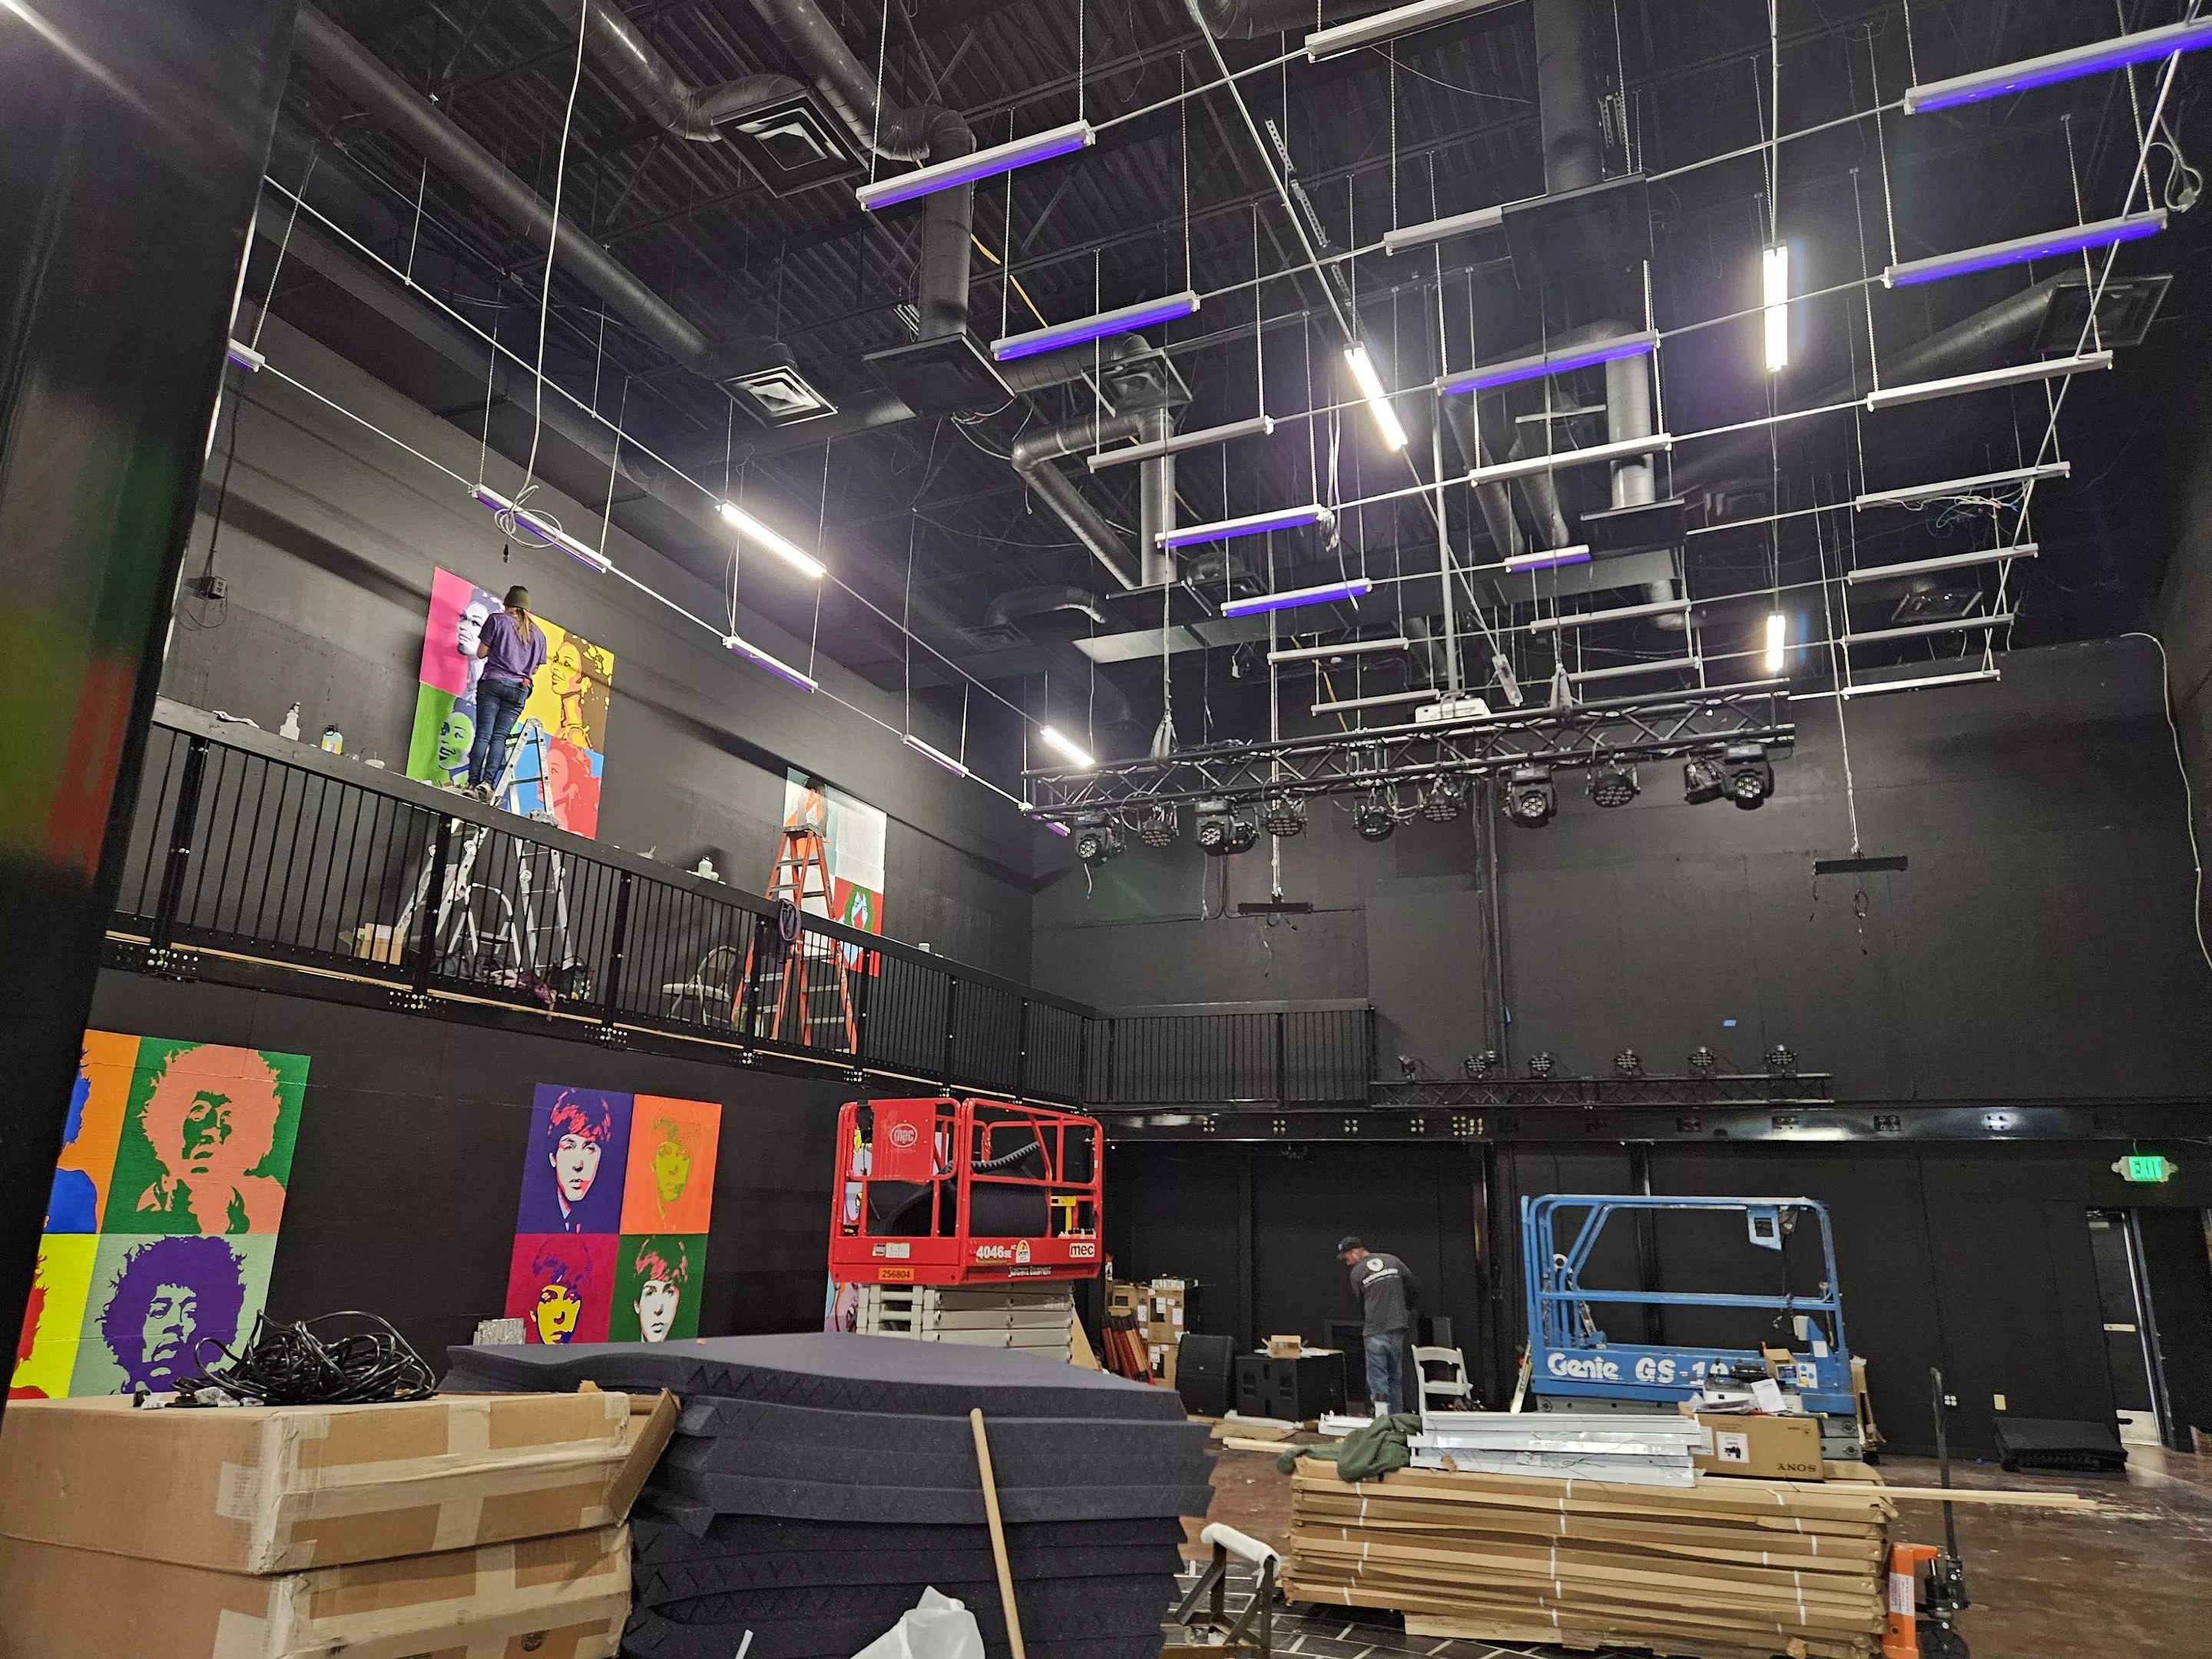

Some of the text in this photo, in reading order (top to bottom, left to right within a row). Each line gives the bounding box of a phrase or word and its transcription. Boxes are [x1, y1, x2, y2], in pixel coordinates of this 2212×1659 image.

[892, 1128, 915, 1143] mec
[2131, 1158, 2162, 1178] EXIT
[1070, 1244, 1094, 1256] mec
[882, 1270, 911, 1279] 256804
[1547, 1353, 1620, 1380] Genie
[1775, 1462, 1816, 1472] SONY
